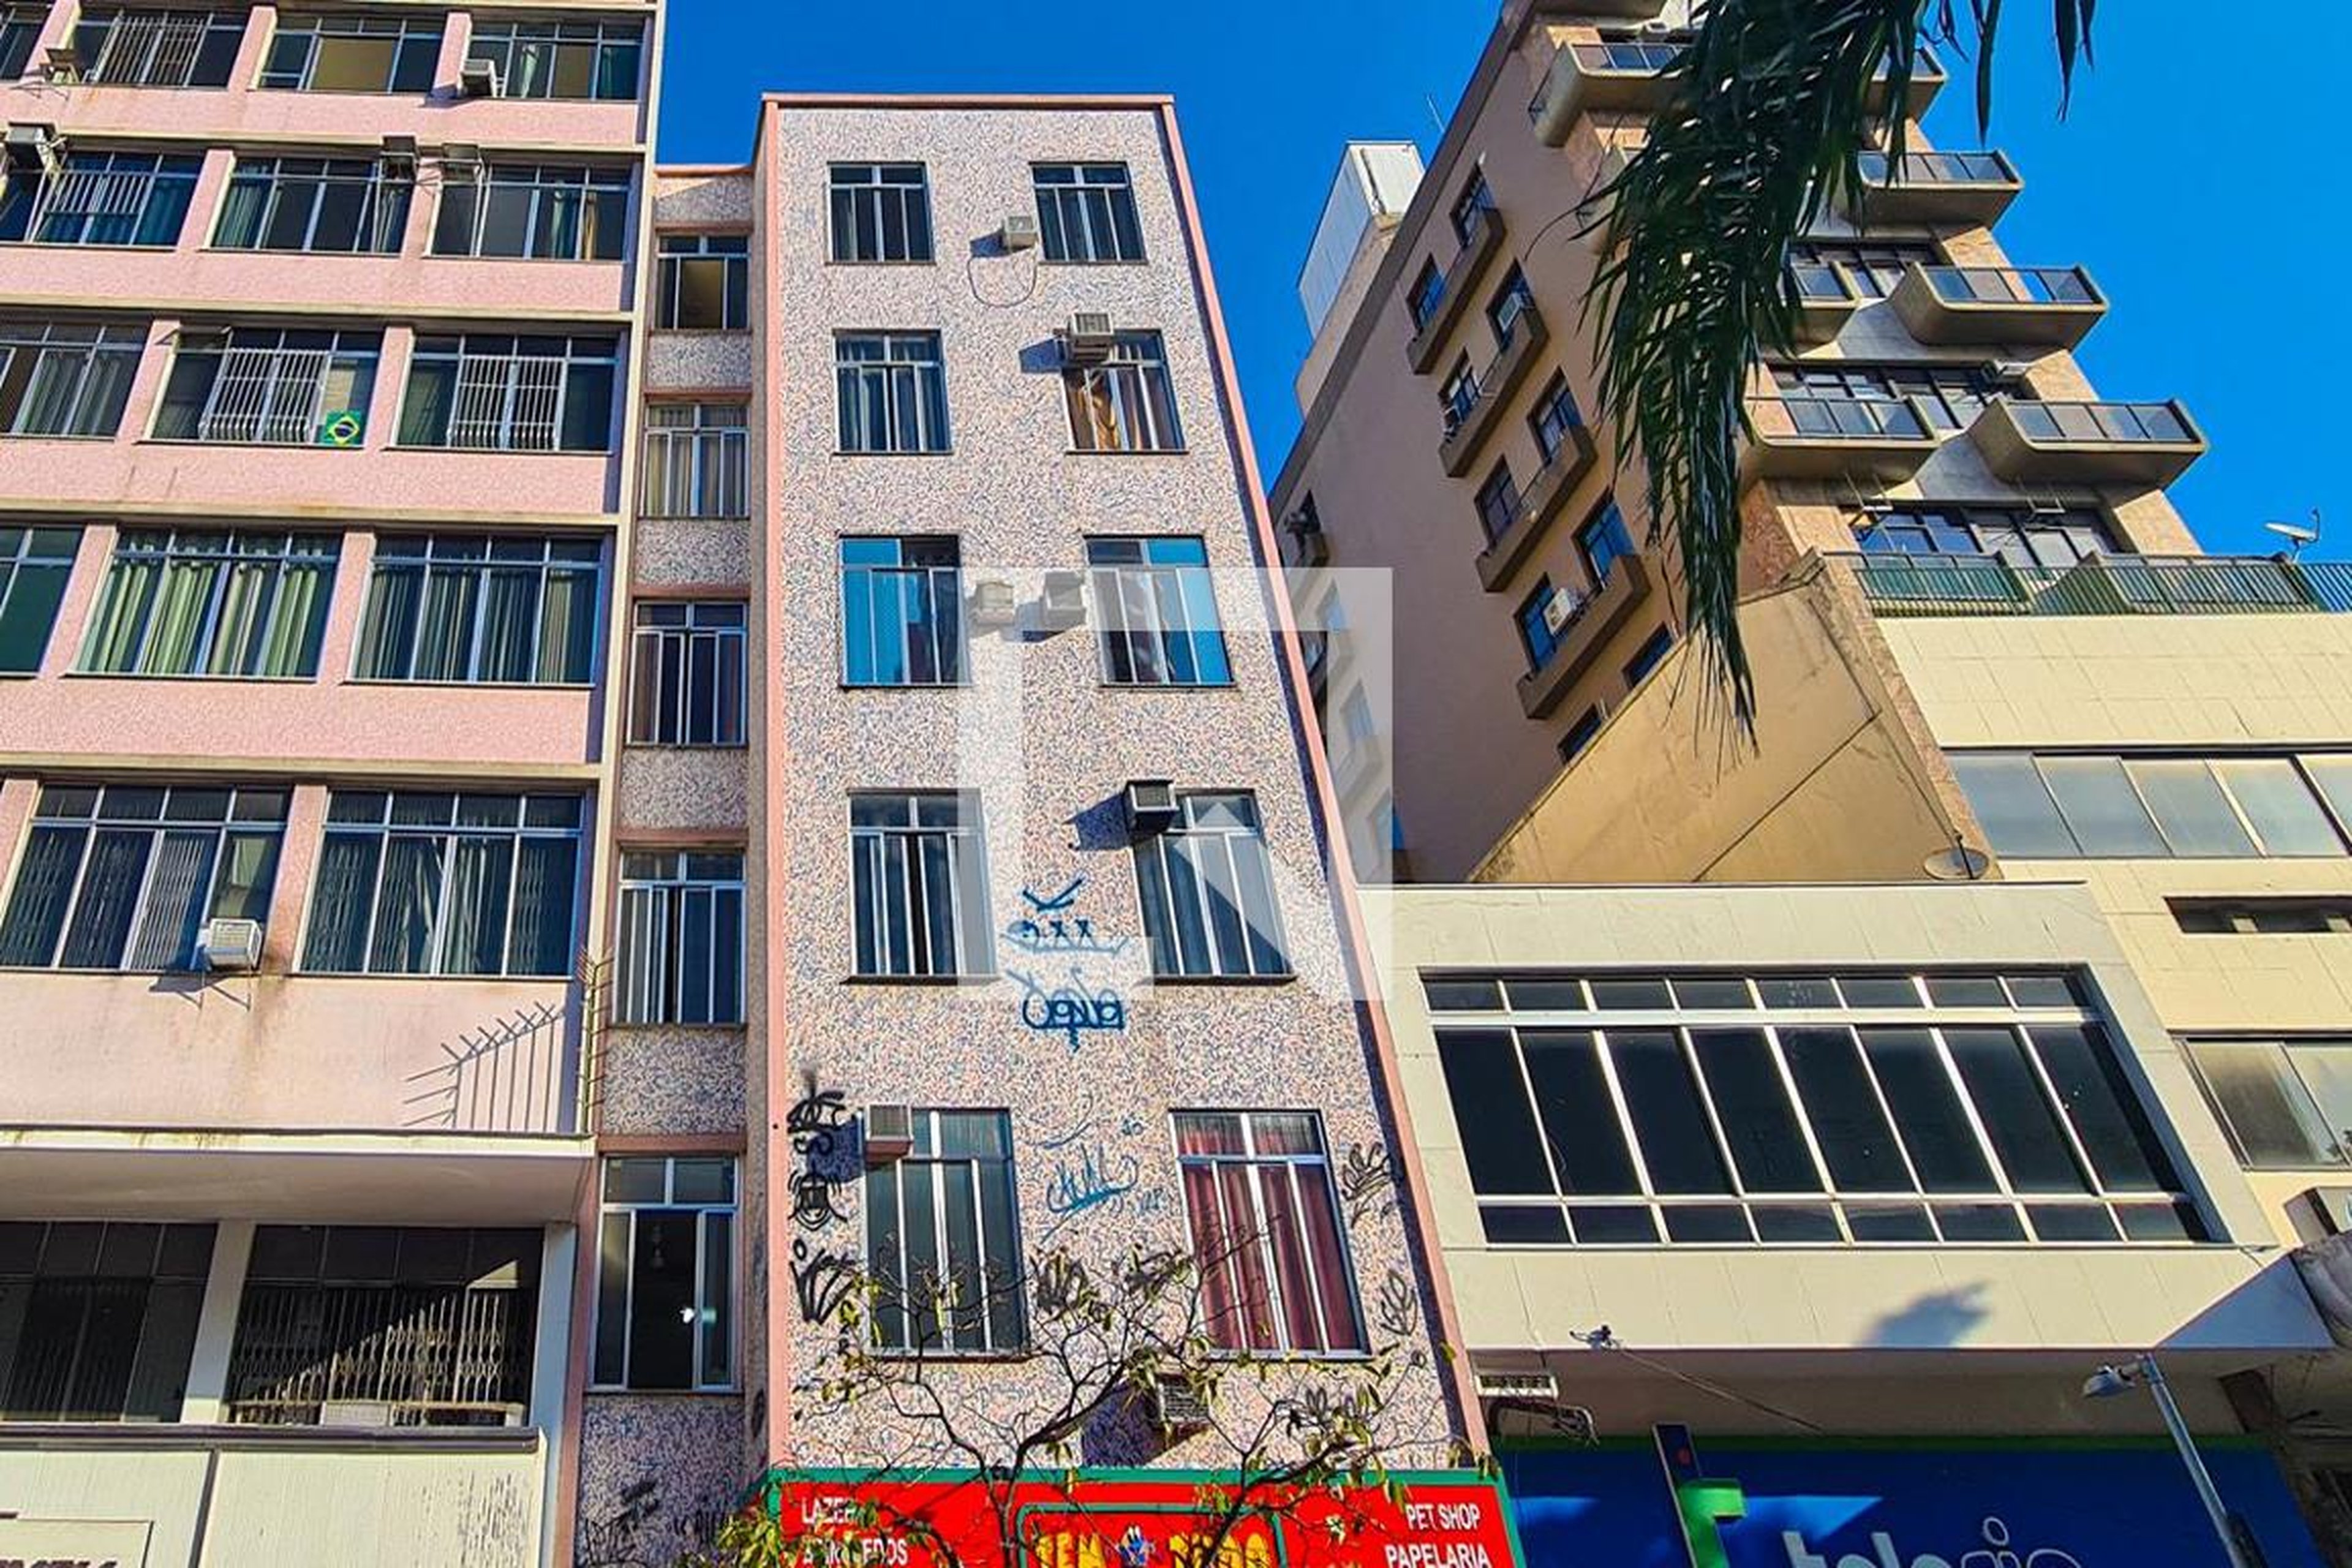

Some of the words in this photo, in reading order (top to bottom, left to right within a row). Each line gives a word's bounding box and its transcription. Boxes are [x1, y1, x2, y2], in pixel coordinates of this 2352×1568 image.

[1404, 1502, 1438, 1530] PET
[1438, 1502, 1481, 1530] SHOP
[1385, 1542, 1493, 1568] PAPELARIA
